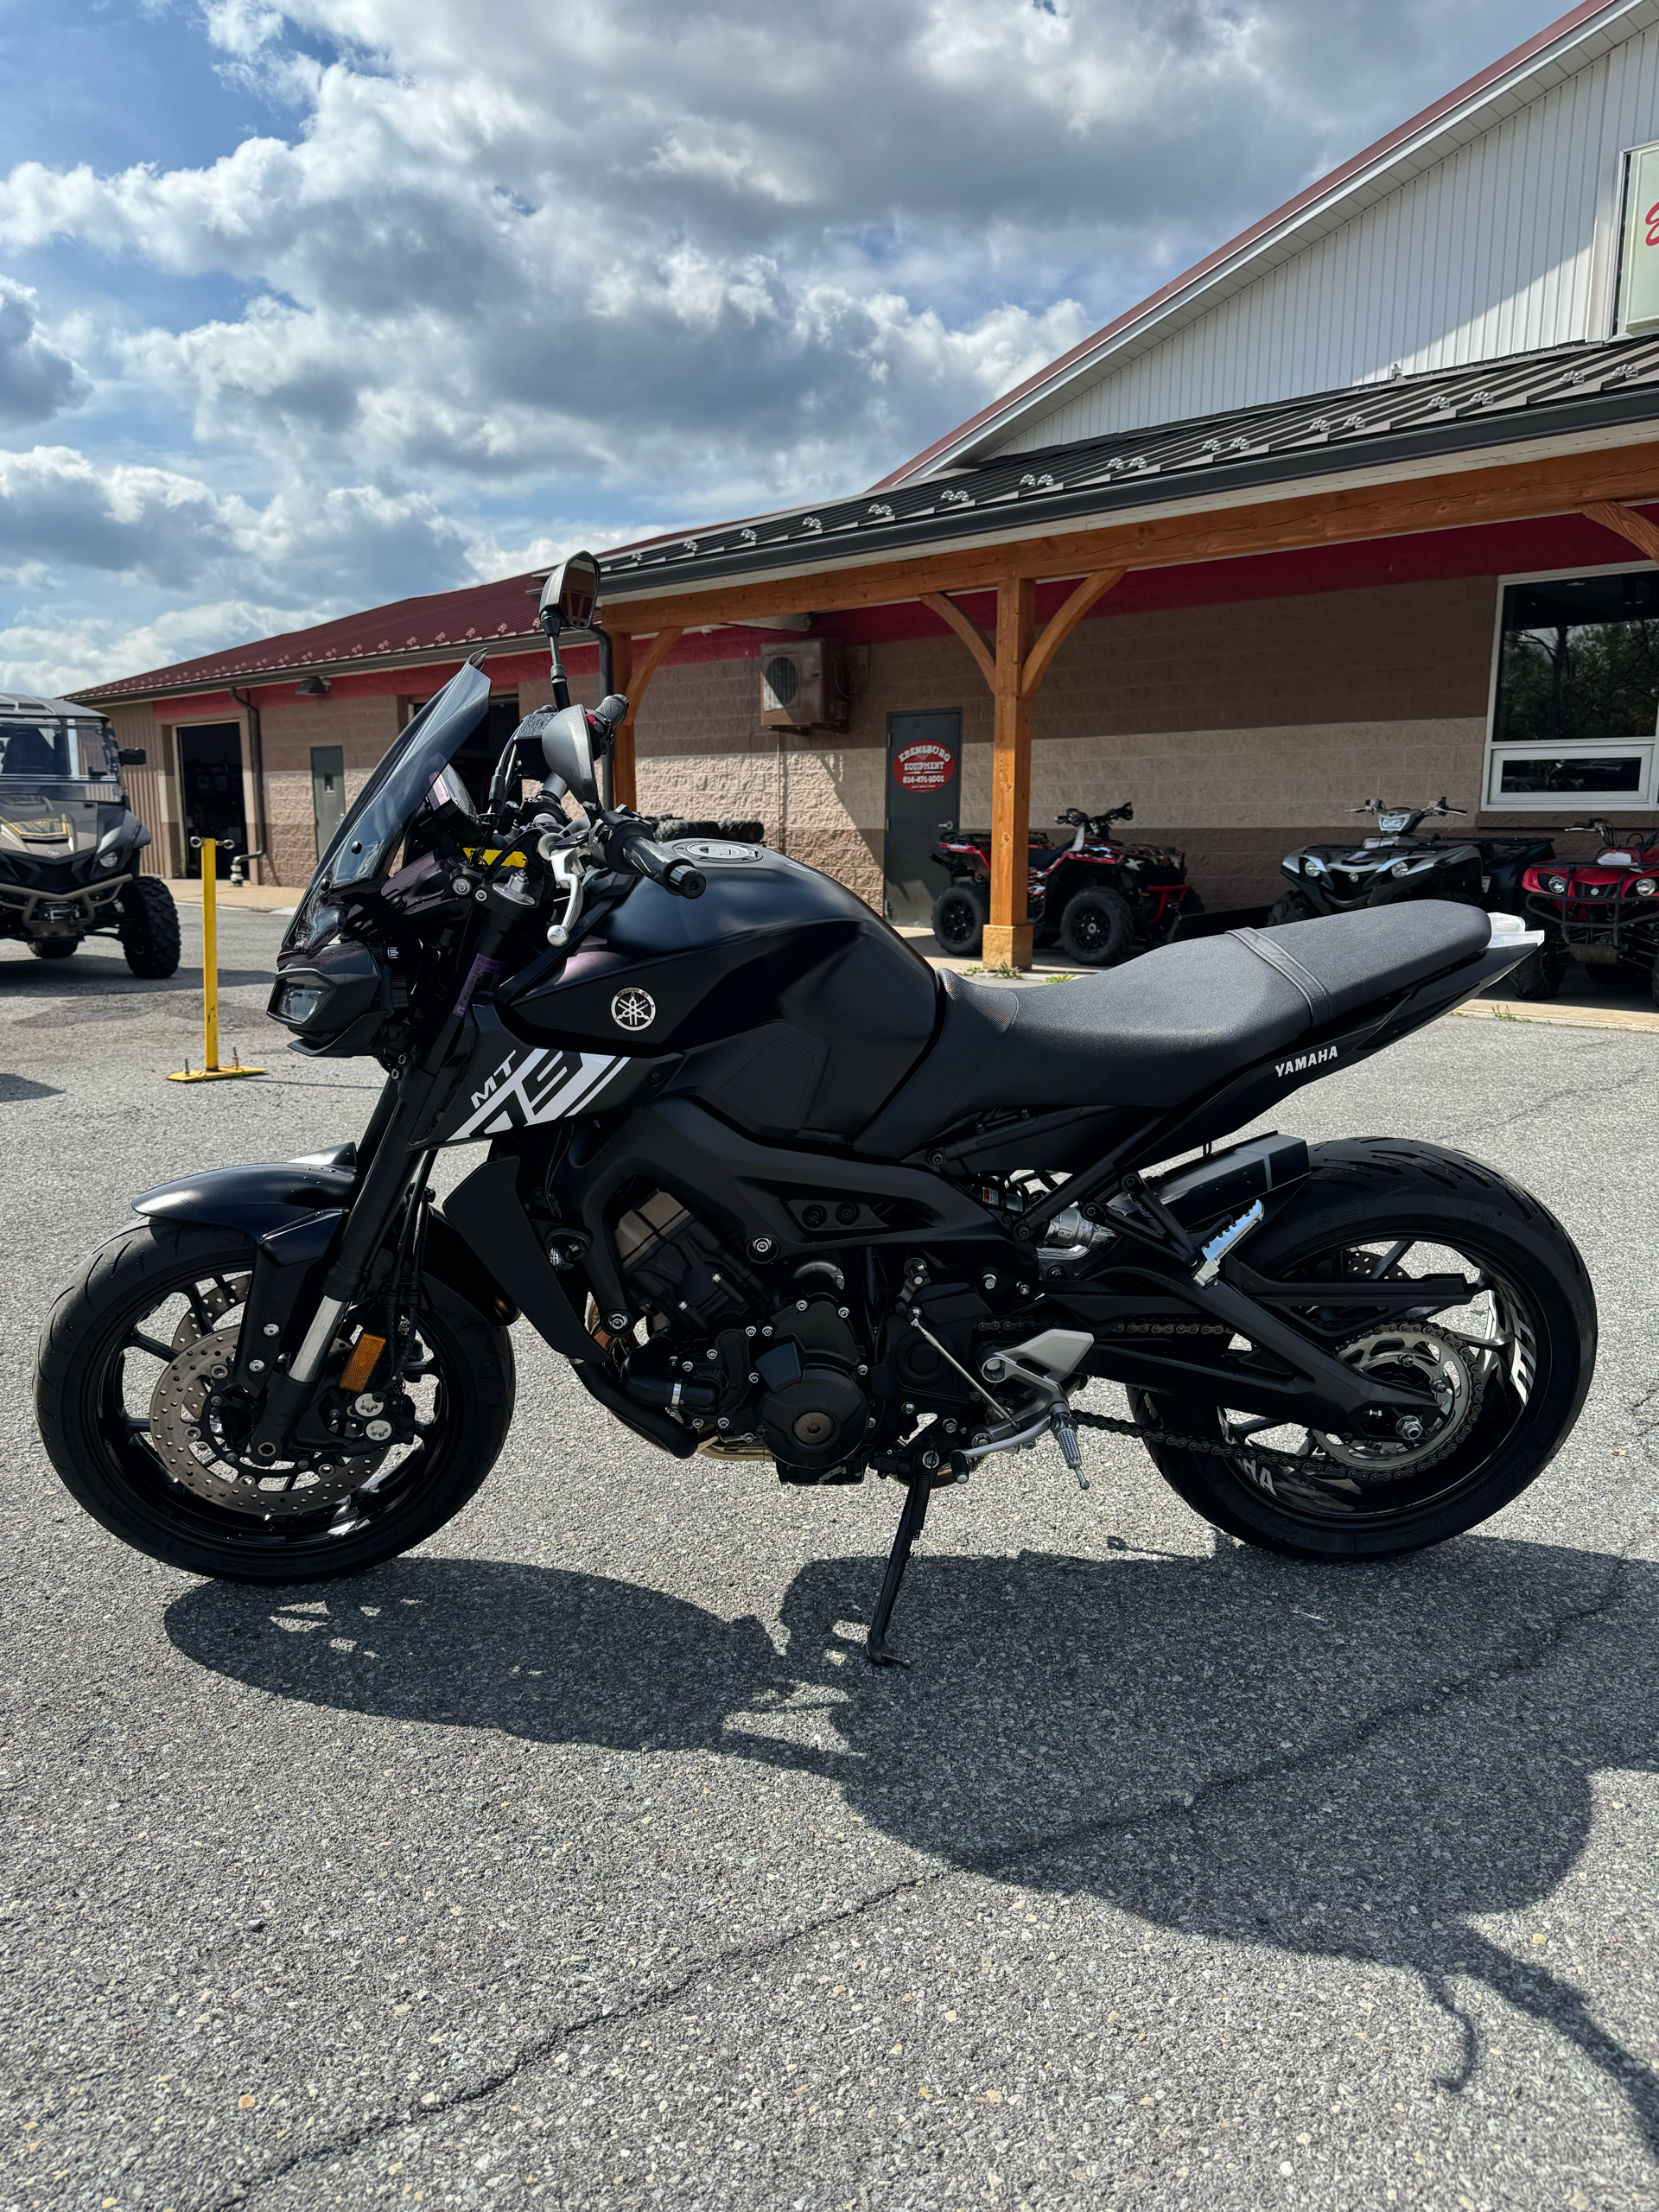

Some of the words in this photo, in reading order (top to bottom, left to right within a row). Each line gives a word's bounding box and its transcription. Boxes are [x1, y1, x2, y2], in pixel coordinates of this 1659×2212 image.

[899, 745, 951, 763] EBENSBURG
[904, 761, 944, 771] EQUIPMENT
[1274, 1046, 1338, 1077] YAMAHA
[470, 1049, 517, 1109] MT
